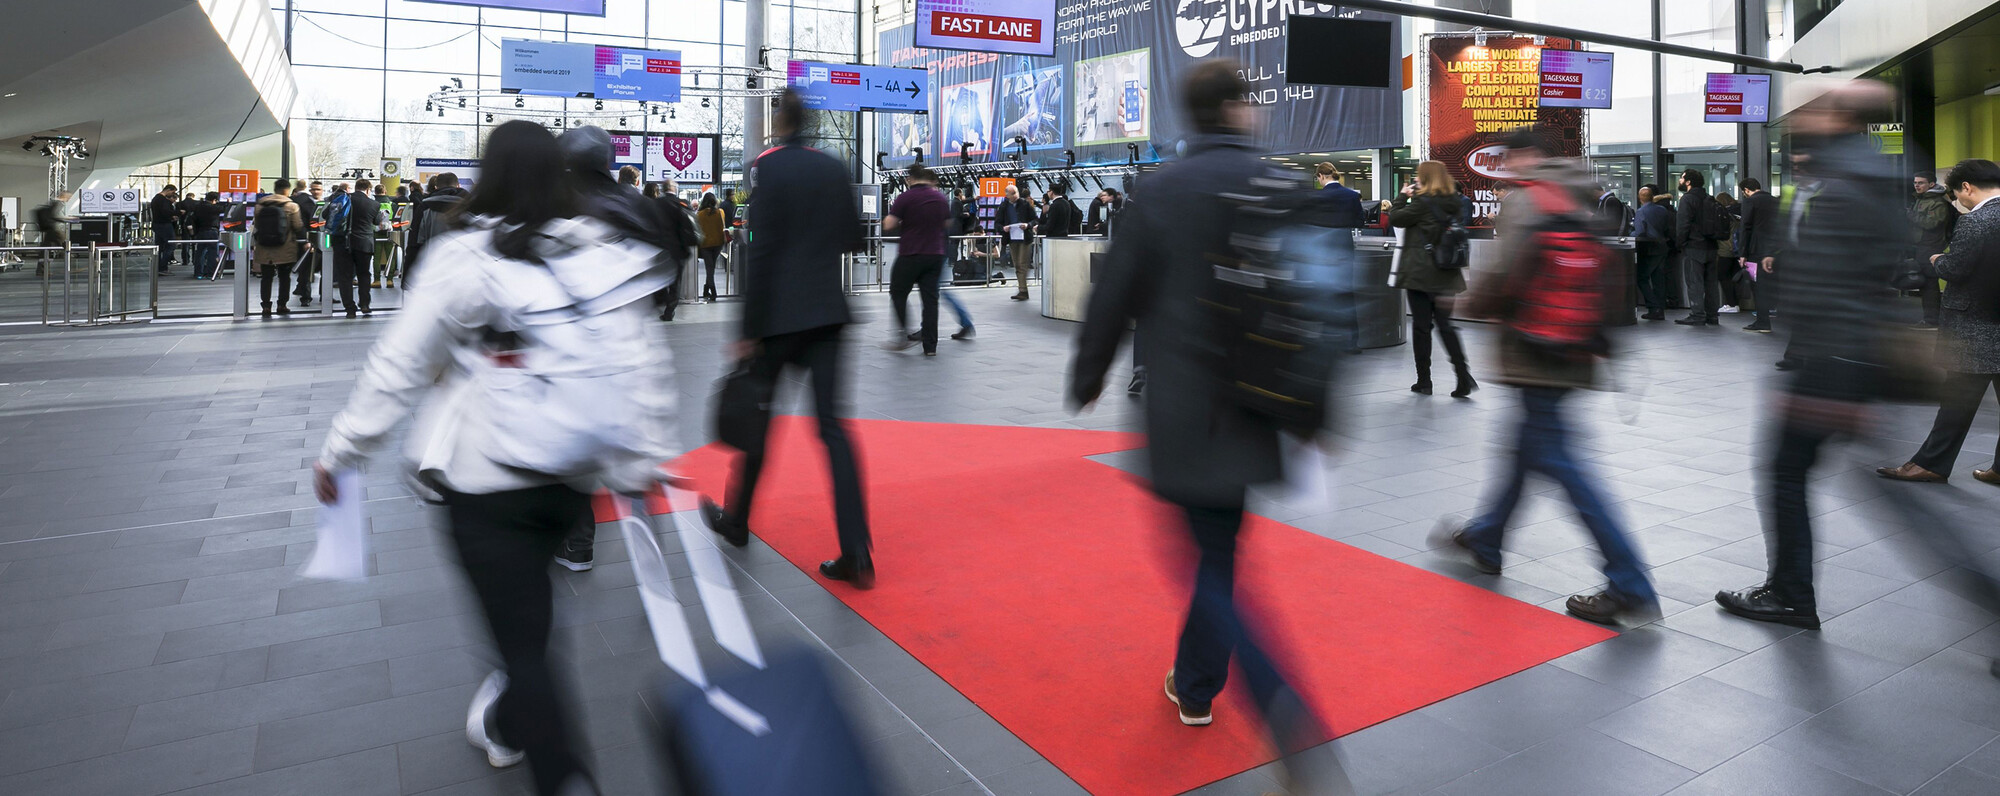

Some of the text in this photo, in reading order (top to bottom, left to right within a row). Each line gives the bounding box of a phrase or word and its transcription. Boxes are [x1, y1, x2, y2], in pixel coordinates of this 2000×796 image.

[1086, 12, 1106, 24] THE
[1108, 6, 1131, 18] WAY
[1133, 1, 1151, 13] WE
[941, 16, 1032, 38] FAST LANE
[1060, 32, 1079, 45] THE
[1081, 24, 1118, 40] WORLD
[1230, 27, 1279, 46] EMBEDDED
[1468, 49, 1540, 60] THE WORLD'S
[1448, 61, 1498, 72] LARGEST
[1462, 73, 1476, 84] OF
[1544, 75, 1579, 83] TAGESKASSE
[865, 78, 870, 91] 1
[885, 80, 901, 93] 4A
[1284, 86, 1314, 101] 148
[1543, 88, 1607, 100] Cashier € 25
[1462, 98, 1524, 108] AVAILABLE
[1473, 110, 1537, 120] IMMEDIATE
[1745, 105, 1751, 115] €
[1753, 105, 1765, 115] 25
[661, 169, 711, 180] Exhib
